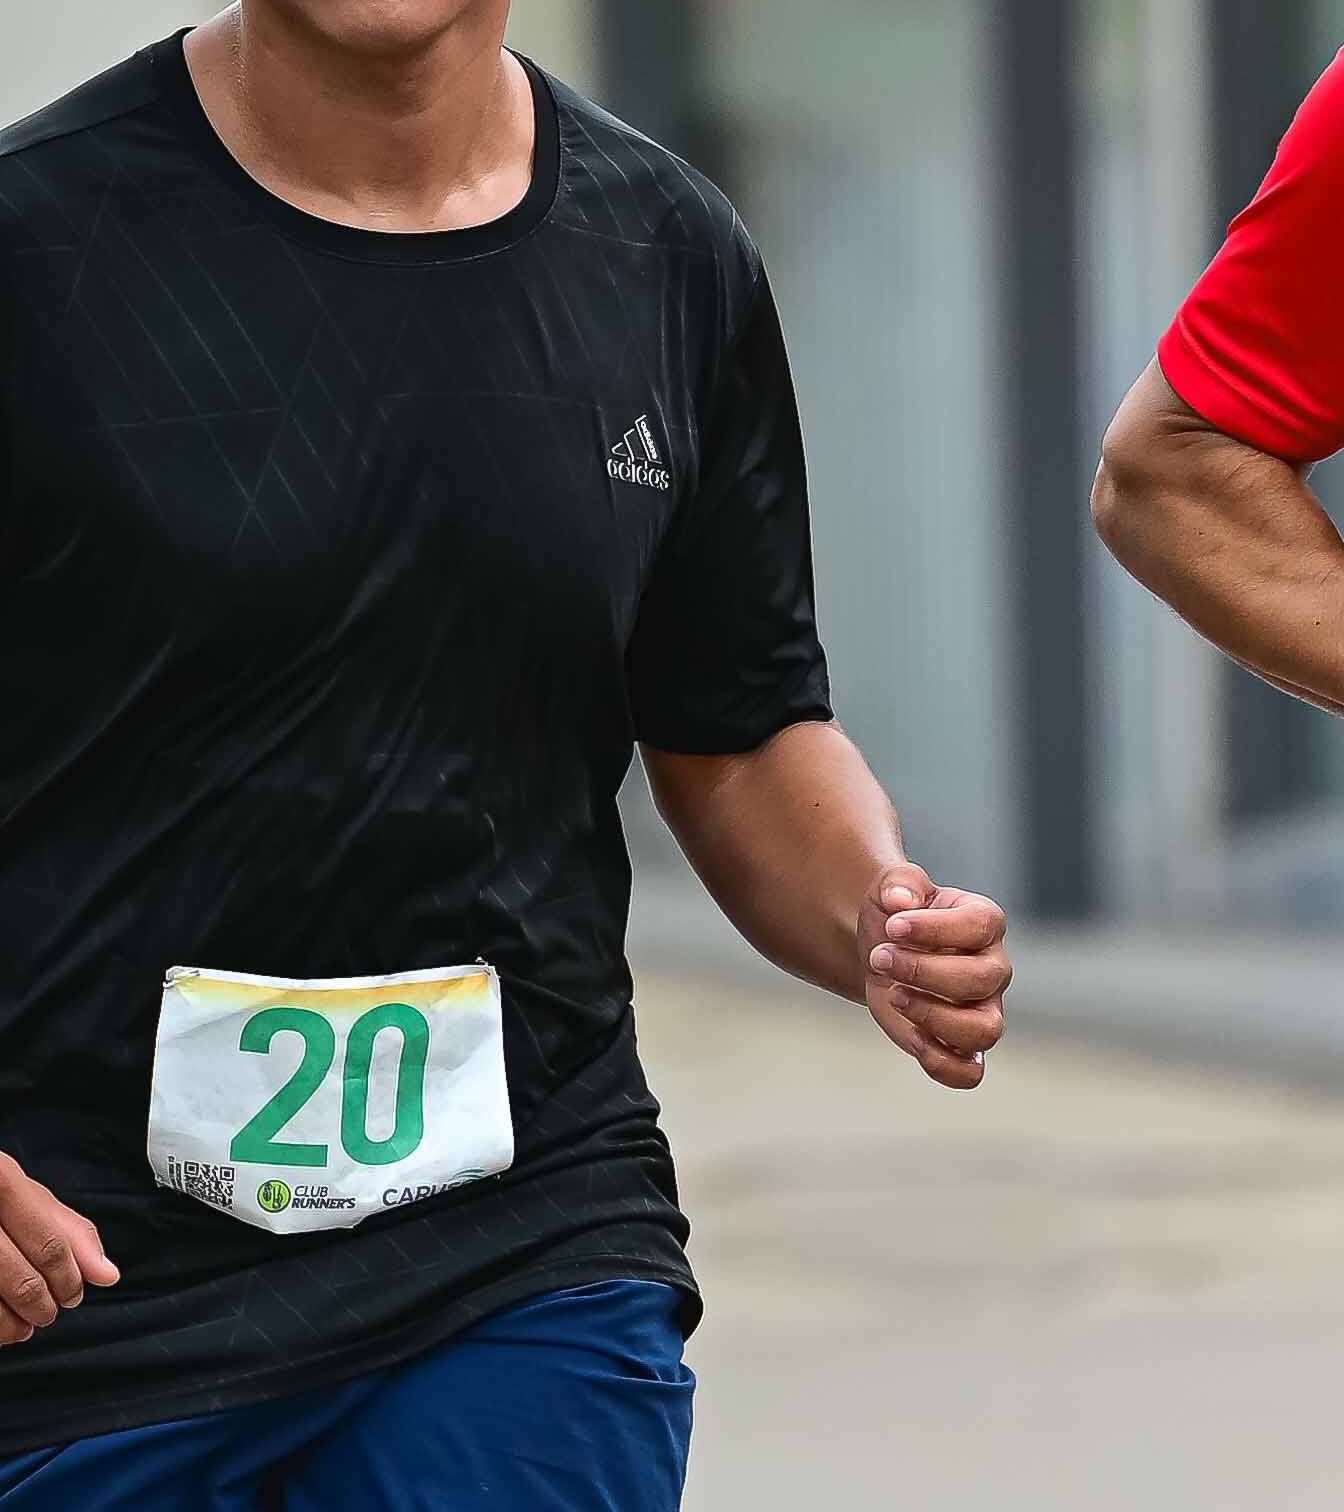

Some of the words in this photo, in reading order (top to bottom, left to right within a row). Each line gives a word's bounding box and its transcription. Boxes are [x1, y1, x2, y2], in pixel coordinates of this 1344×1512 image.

[606, 456, 670, 490] adidas
[229, 1002, 430, 1167] 20
[291, 1197, 356, 1210] RUNNER'S
[294, 1185, 329, 1198] CLUB
[382, 1182, 462, 1207] CAR
